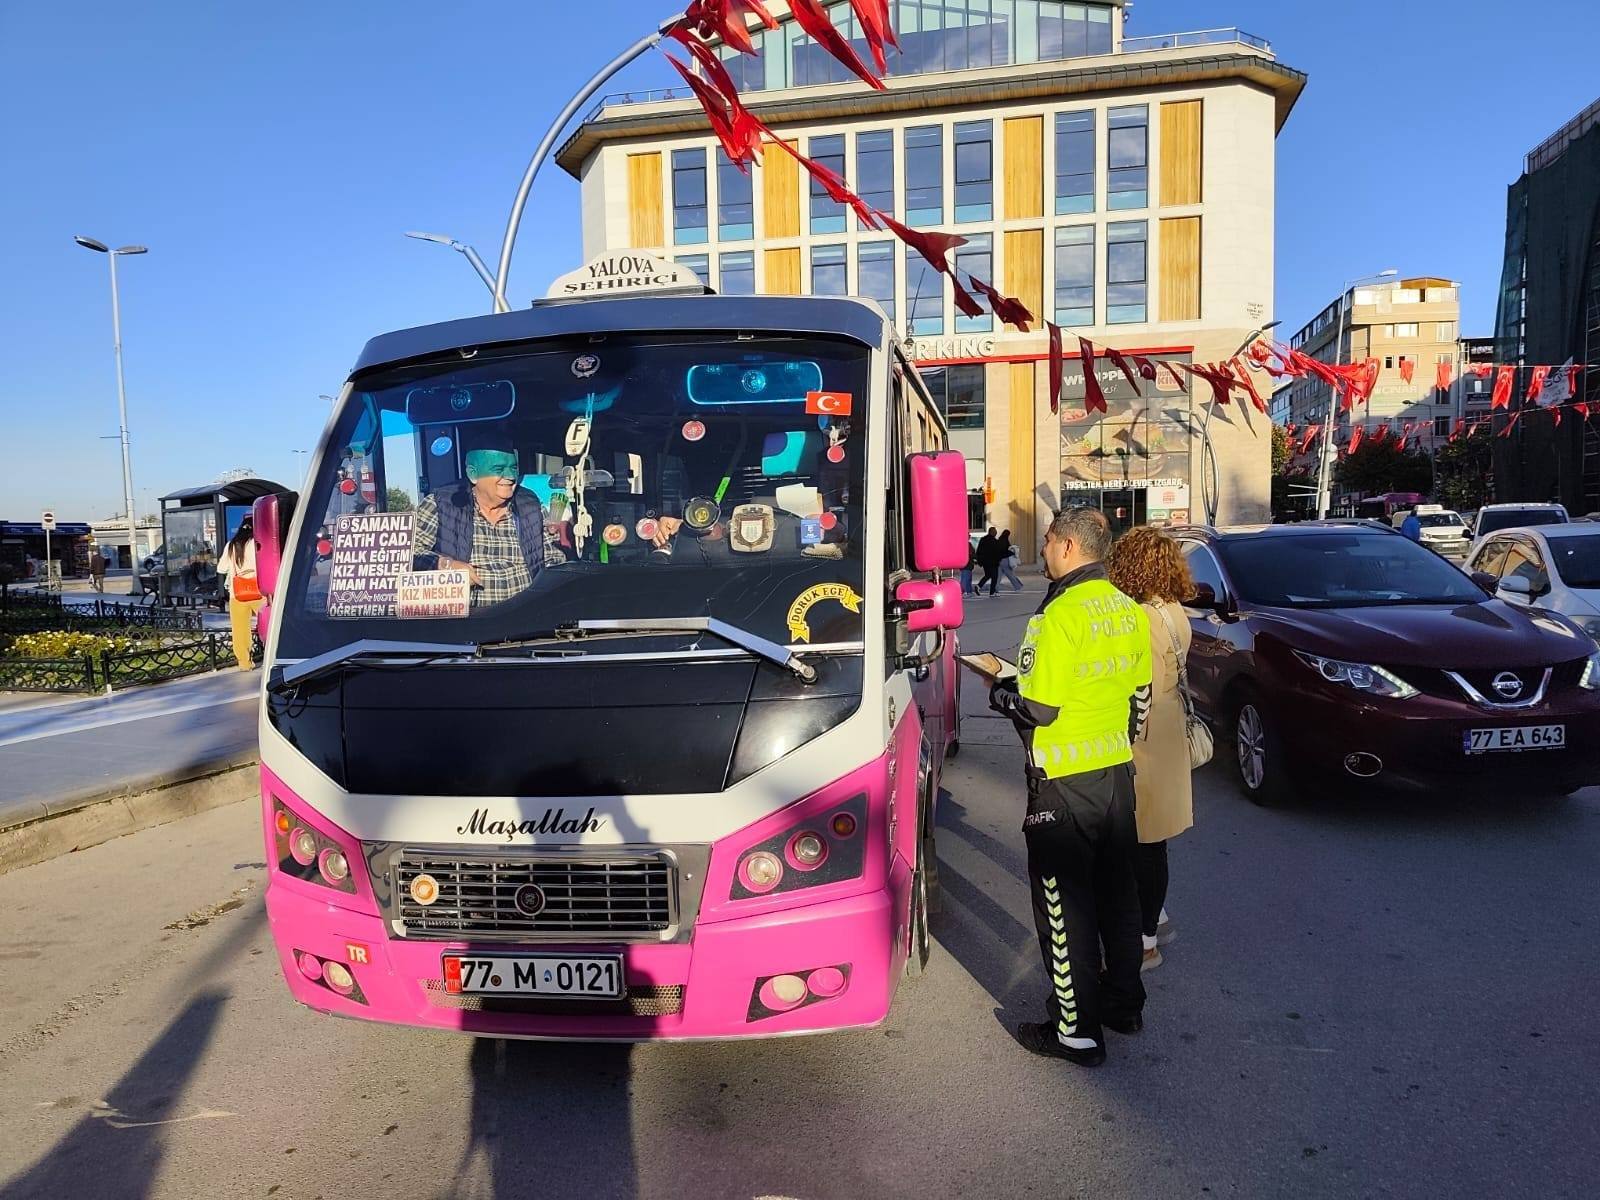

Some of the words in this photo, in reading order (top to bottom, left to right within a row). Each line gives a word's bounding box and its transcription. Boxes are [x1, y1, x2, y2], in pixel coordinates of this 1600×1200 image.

[589, 256, 654, 278] YALOVA
[564, 271, 679, 294] ŞEHİRİÇİ
[936, 337, 996, 360] KING
[572, 423, 586, 441] F
[351, 515, 413, 532] SAMANLI
[379, 531, 411, 547] CAD.
[335, 550, 368, 563] HALK
[333, 564, 355, 577] KIZ
[358, 562, 409, 576] MESLEK
[438, 572, 466, 585] CAD.
[402, 587, 420, 600] KIZ
[423, 586, 464, 600] MESLEK
[329, 602, 385, 617] ÖĞRETMEN
[791, 590, 820, 622] DORUK
[823, 587, 845, 597] EGE
[1471, 730, 1494, 748] 77
[1500, 729, 1526, 747] EA
[1532, 726, 1563, 745] 643
[456, 807, 608, 843] Maşallah
[347, 944, 368, 964] TR
[461, 961, 494, 989] 77
[513, 962, 537, 989] M
[556, 962, 615, 992] 0121
